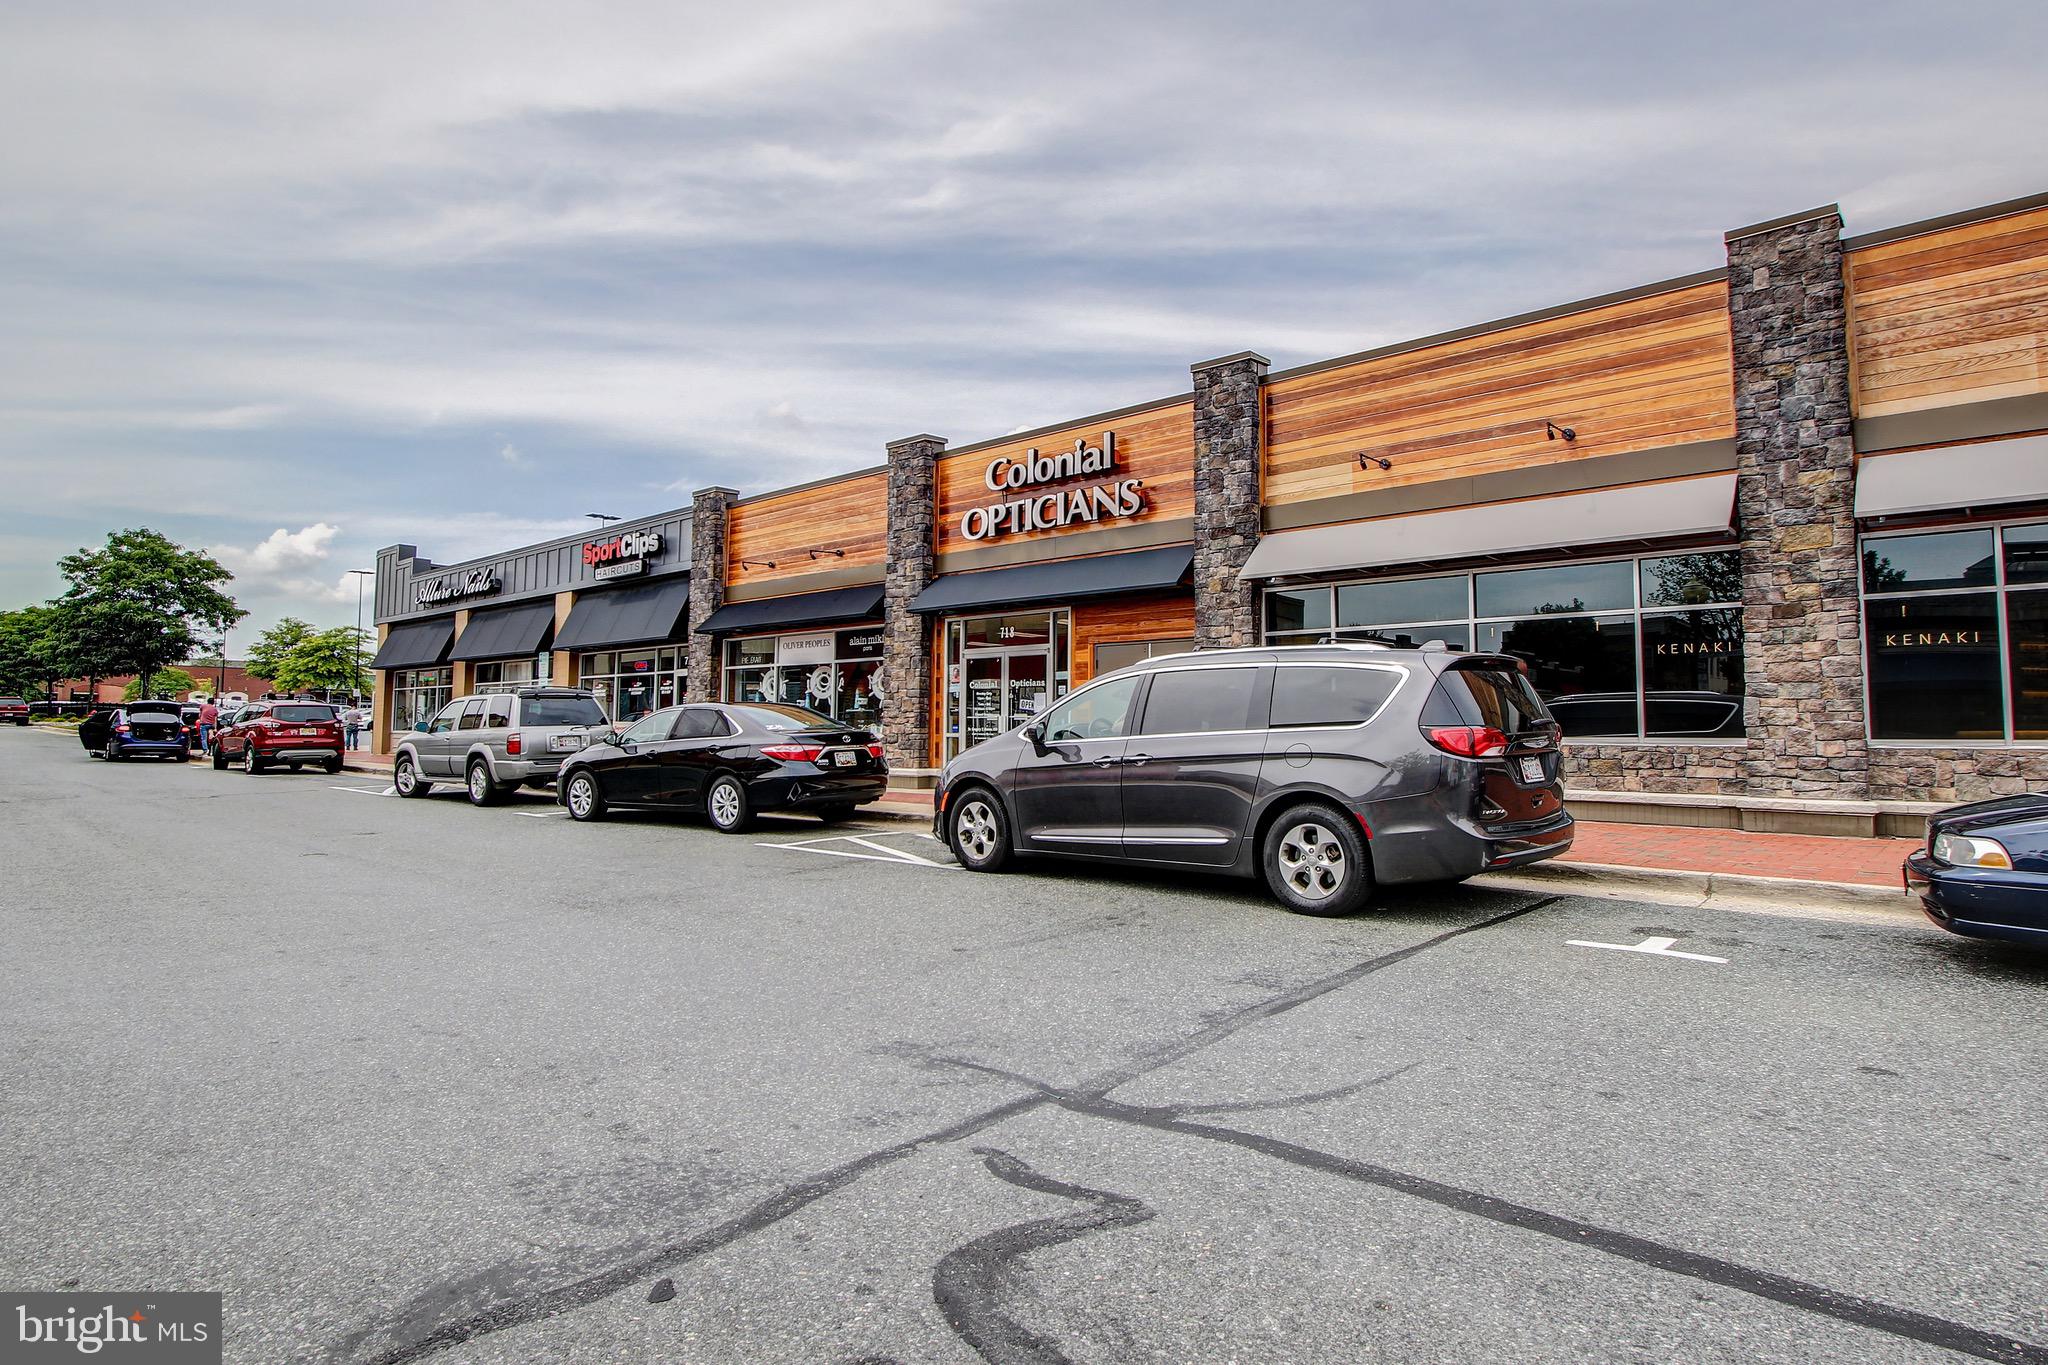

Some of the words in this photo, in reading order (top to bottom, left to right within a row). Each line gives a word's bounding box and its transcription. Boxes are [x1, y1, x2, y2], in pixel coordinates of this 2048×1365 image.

[985, 430, 1113, 491] Colonial
[960, 479, 1143, 540] OPTICIANS
[596, 562, 641, 578] HAIRCUTS
[414, 579, 452, 604] Allure
[453, 568, 492, 596] Nails
[1000, 626, 1015, 638] 718
[1886, 631, 1979, 646] KENAKI
[782, 641, 805, 650] OLIVER
[805, 638, 831, 649] PEOPLES
[849, 636, 867, 646] alain
[868, 634, 885, 645] mikl
[1657, 641, 1732, 655] KENAKI
[969, 680, 998, 689] Colonial
[1010, 679, 1046, 689] Opticians
[1021, 700, 1034, 709] OPEN
